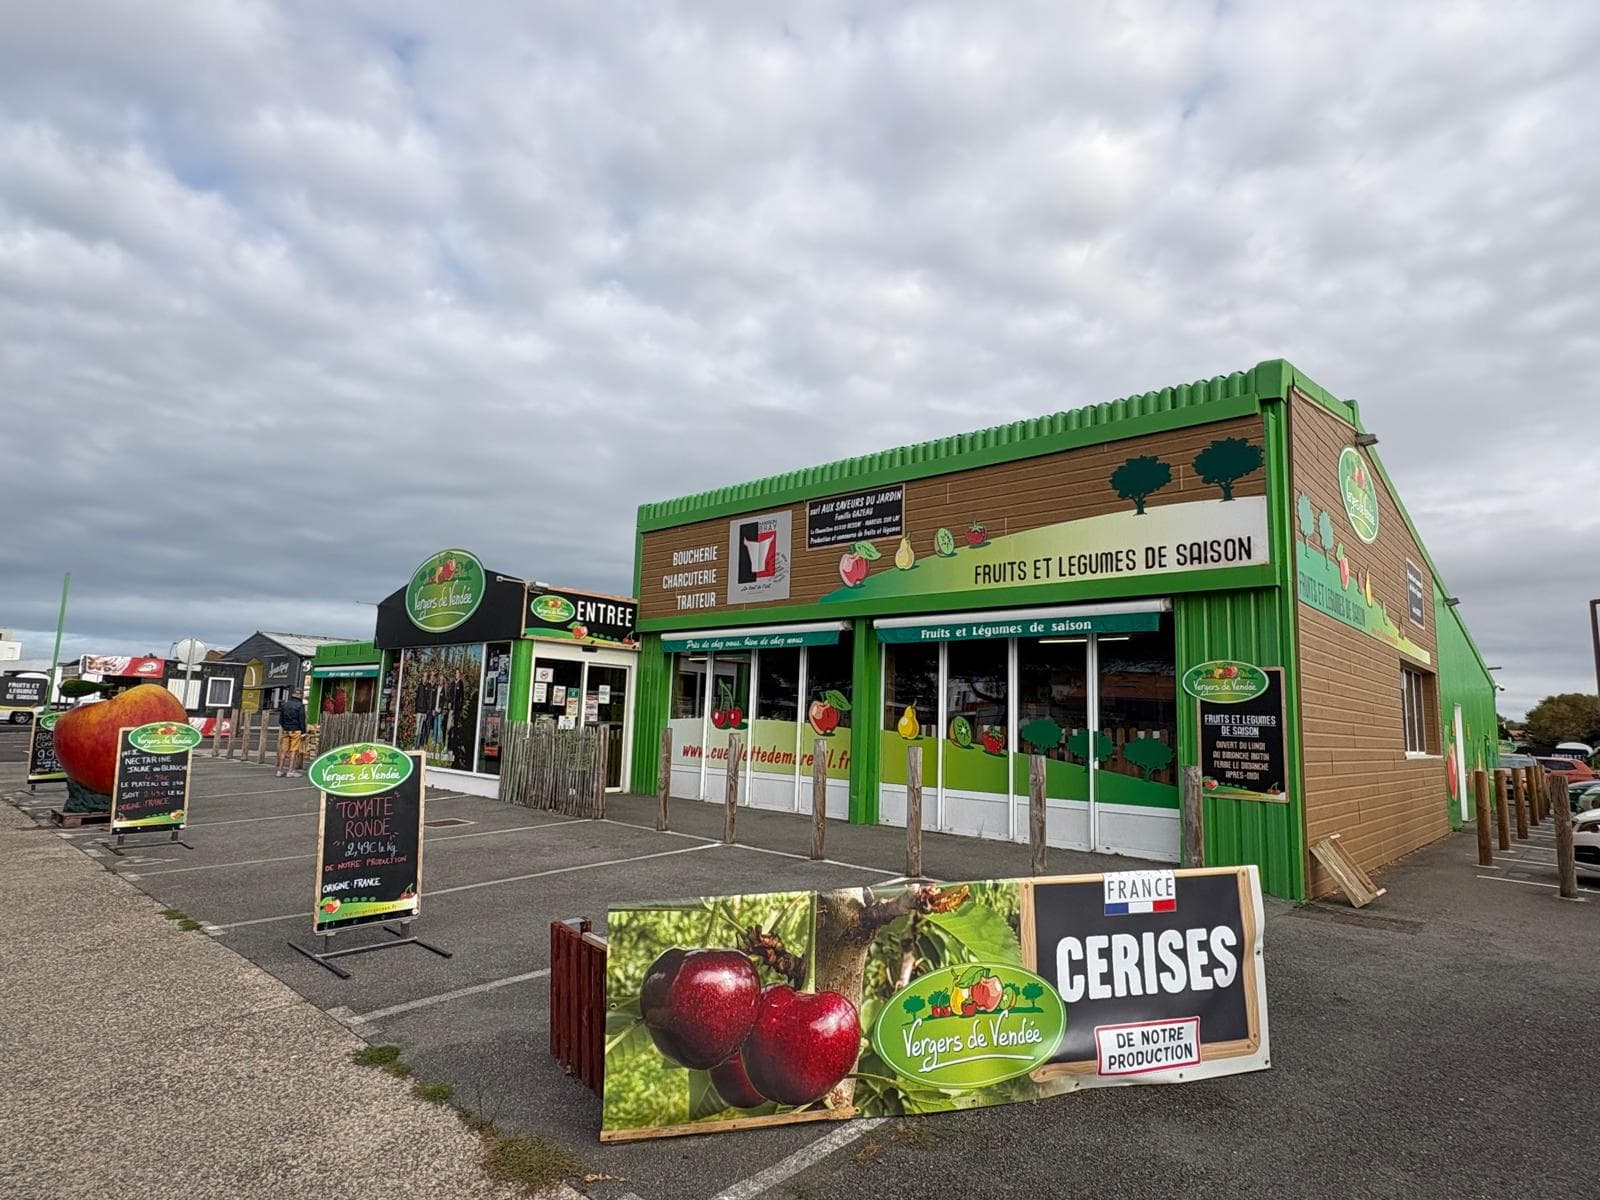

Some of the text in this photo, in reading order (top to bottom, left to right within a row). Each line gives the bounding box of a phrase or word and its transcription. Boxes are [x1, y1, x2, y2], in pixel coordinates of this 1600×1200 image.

[821, 502, 836, 514] AUX
[836, 497, 865, 511] SAVEURS
[866, 495, 876, 505] DU
[876, 490, 902, 504] JARDIN
[852, 507, 874, 518] GAZEAU
[672, 545, 718, 566] BOUCHERIE
[974, 536, 1252, 585] FRUITS ET LEGUMES DE SAISON
[662, 568, 717, 589] CHARCUTERIE
[414, 579, 472, 619] Vergers de Vendée
[677, 592, 716, 611] TRAITEUR
[576, 601, 633, 627] ENTREE
[921, 620, 1092, 639] Fruits et Légumes de saison
[701, 640, 709, 648] de
[711, 640, 724, 649] chez
[743, 636, 758, 646] bien
[760, 636, 768, 645] de
[770, 635, 785, 646] chez
[787, 636, 804, 644] nous
[1193, 677, 1257, 696] Vergers de Vendée
[1204, 714, 1277, 725] FRUITS ET LEGUMES
[1221, 726, 1259, 736] DE SAISON
[1216, 741, 1238, 749] OUVERT
[125, 756, 172, 766] NECTARINE
[127, 765, 150, 774] JAUNE
[161, 764, 188, 772] BLANCH
[1232, 761, 1239, 769] LE
[322, 764, 401, 788] Vergers de Vendée
[336, 796, 394, 819] TOMATE
[345, 817, 391, 839] RONDE
[338, 860, 361, 870] NOTRE
[366, 856, 407, 867] PRODUCTION
[353, 877, 381, 888] FRANCE
[1107, 877, 1173, 900] FRANCE
[1056, 925, 1238, 1003] CERISES
[903, 1009, 1043, 1071] Vergers de Vendée
[1116, 1026, 1185, 1049] DE NOTRE
[1108, 1042, 1193, 1070] PRODUCTION
